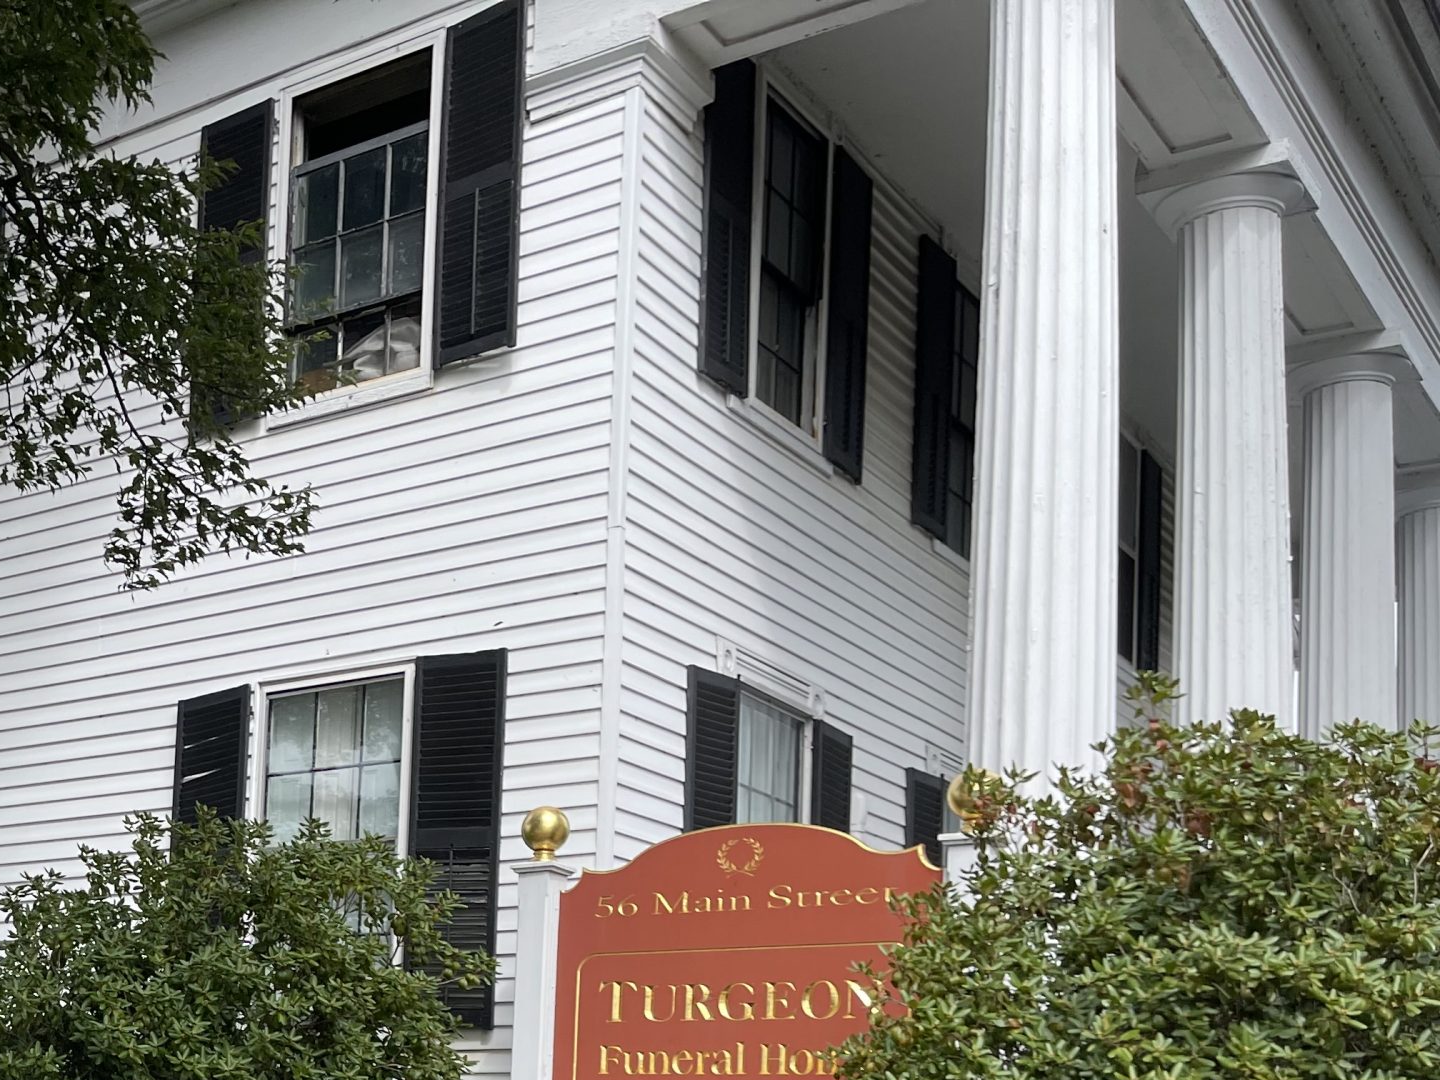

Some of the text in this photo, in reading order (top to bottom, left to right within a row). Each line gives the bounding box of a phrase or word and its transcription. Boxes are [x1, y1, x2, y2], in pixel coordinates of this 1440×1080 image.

[594, 884, 899, 918] 56 Main Street
[598, 979, 886, 1024] TURGEON
[597, 1042, 747, 1076] Funeral
